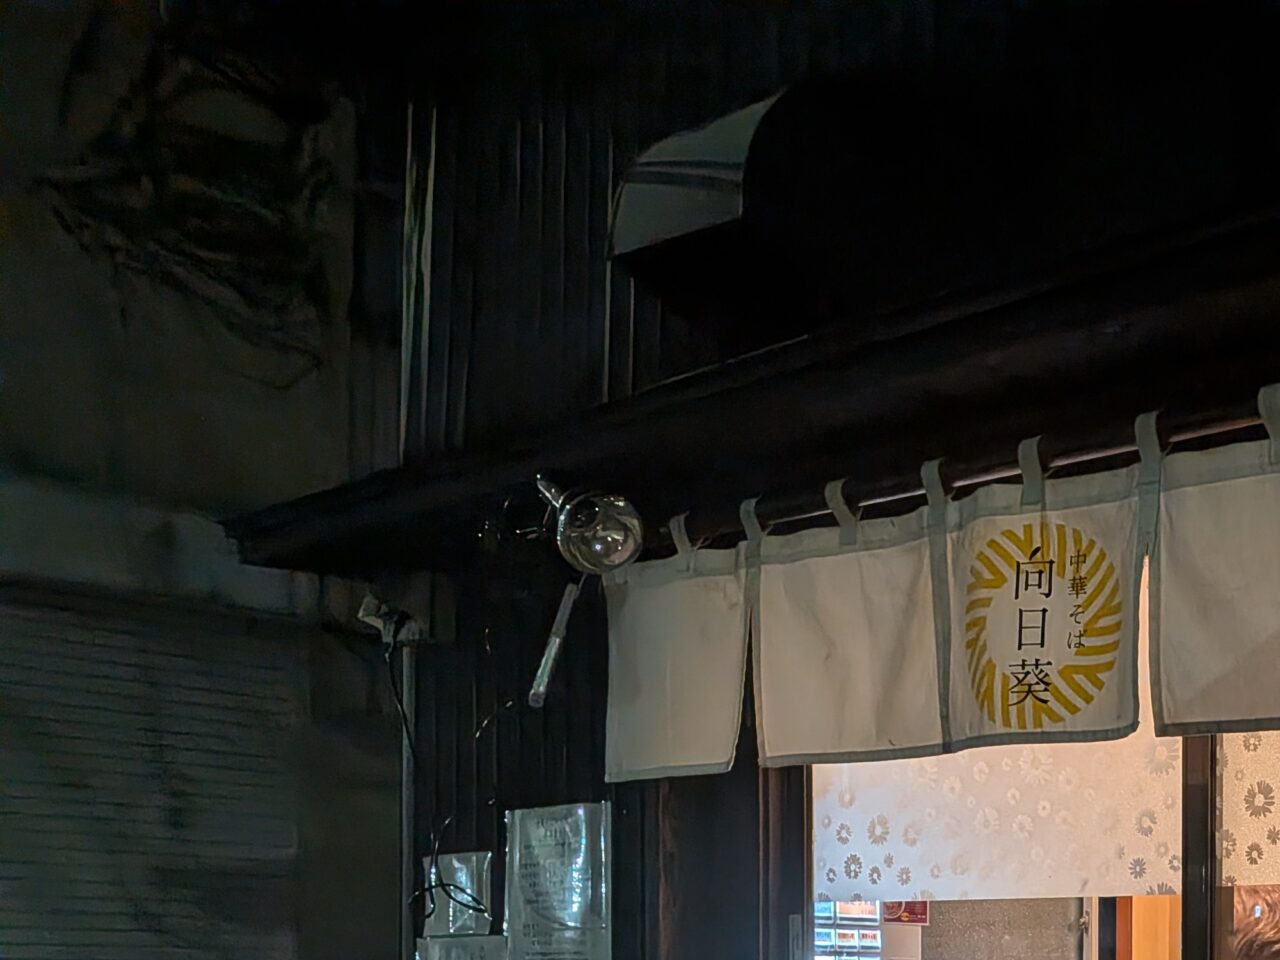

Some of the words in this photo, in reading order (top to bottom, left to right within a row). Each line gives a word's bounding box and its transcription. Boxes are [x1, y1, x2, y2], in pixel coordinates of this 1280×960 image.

[1008, 546, 1055, 707] 向日葵
[1066, 550, 1087, 650] 中華そば
